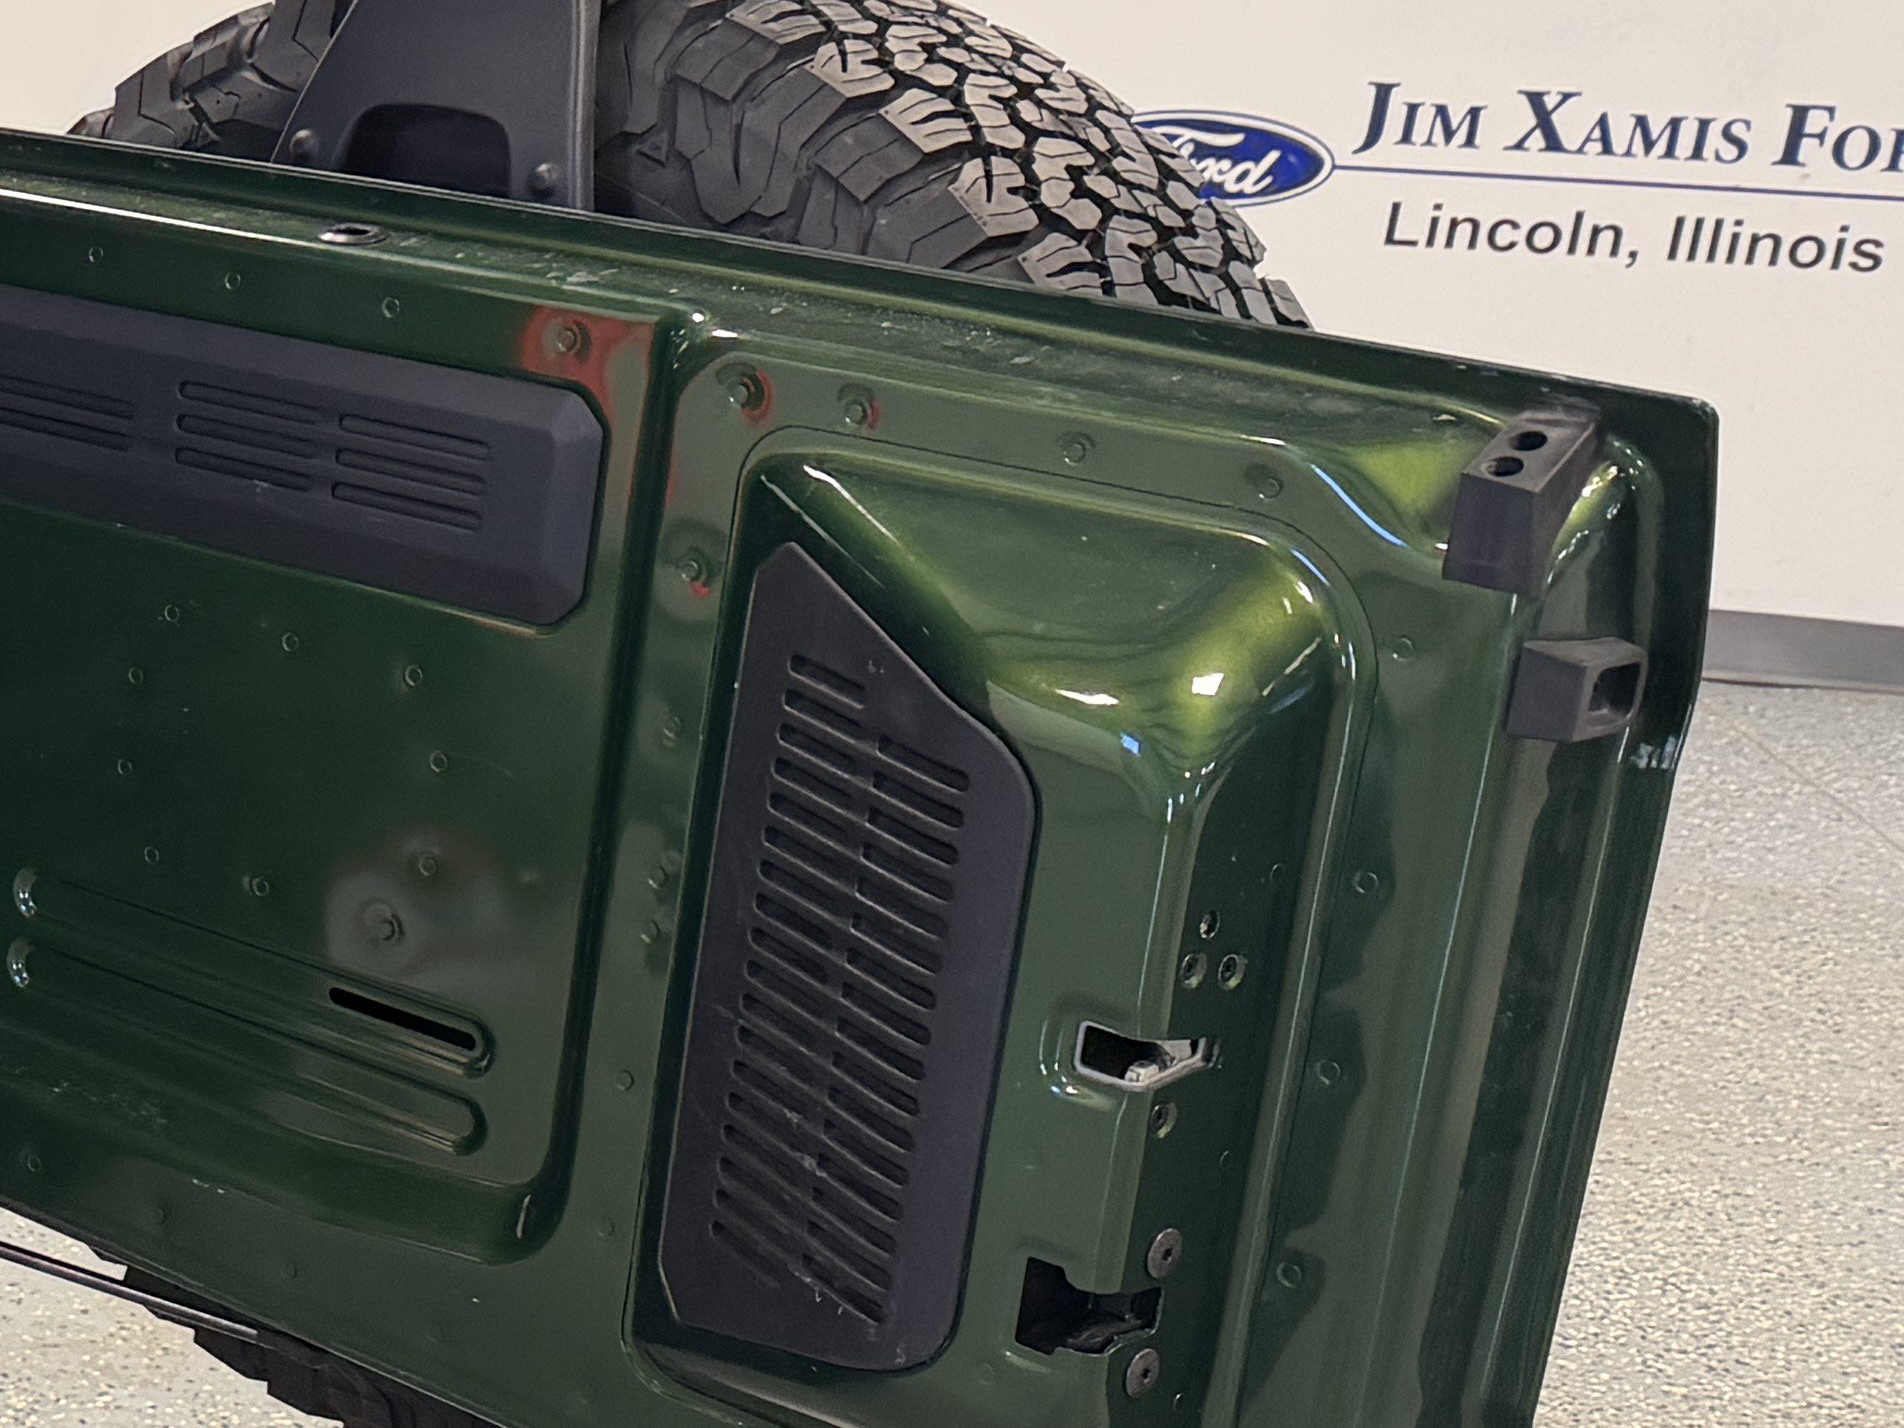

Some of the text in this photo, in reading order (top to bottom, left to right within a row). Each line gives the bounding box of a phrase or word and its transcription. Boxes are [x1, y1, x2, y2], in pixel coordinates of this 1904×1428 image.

[1352, 81, 1485, 155] JIM
[1503, 89, 1751, 164] XAMIS
[1383, 201, 1884, 273] Lincoln, Illinois
